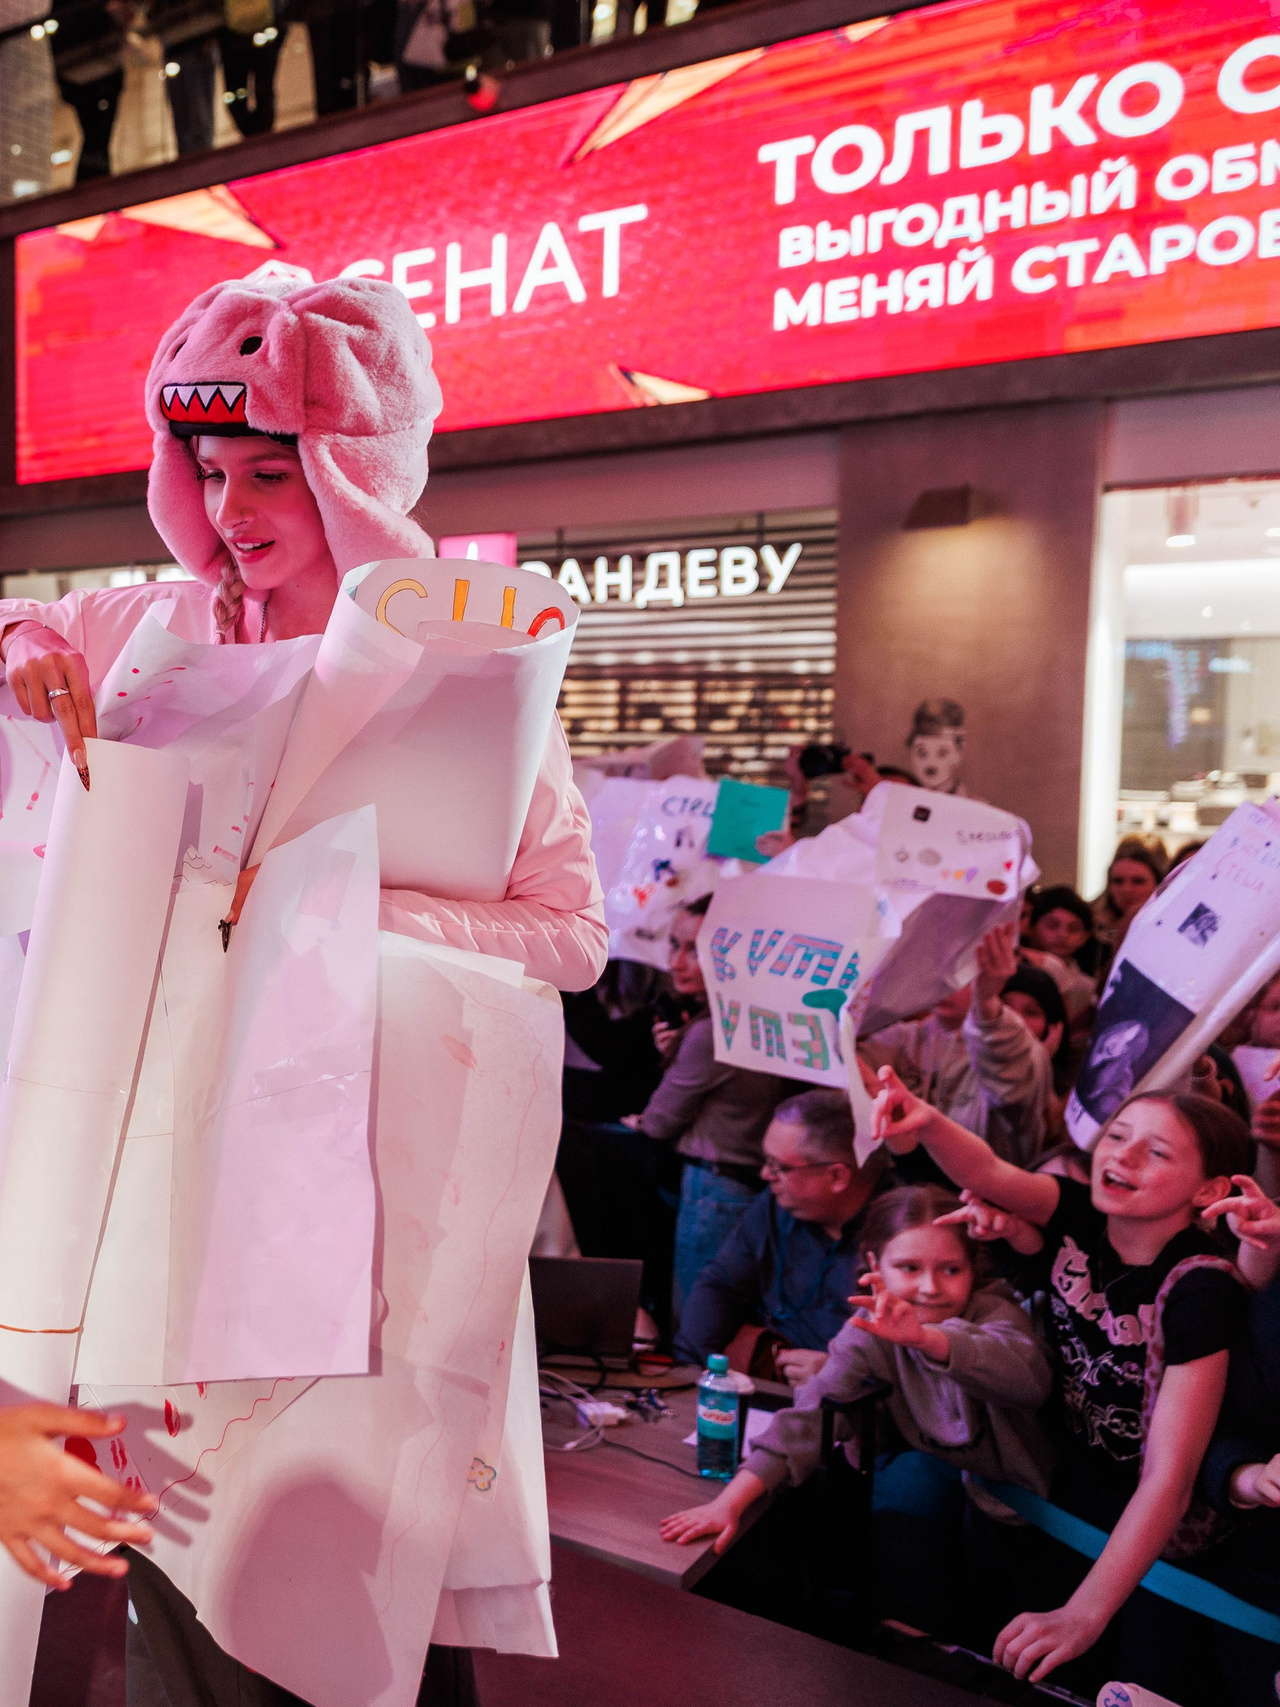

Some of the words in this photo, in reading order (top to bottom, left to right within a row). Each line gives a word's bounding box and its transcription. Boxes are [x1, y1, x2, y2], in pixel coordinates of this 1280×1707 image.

[758, 61, 1184, 205] ТОЛЬКО
[338, 203, 649, 328] ЕНАТ
[778, 155, 1138, 269] ВЫГОДНЫЙ
[773, 245, 993, 331] МЕНЯЙ
